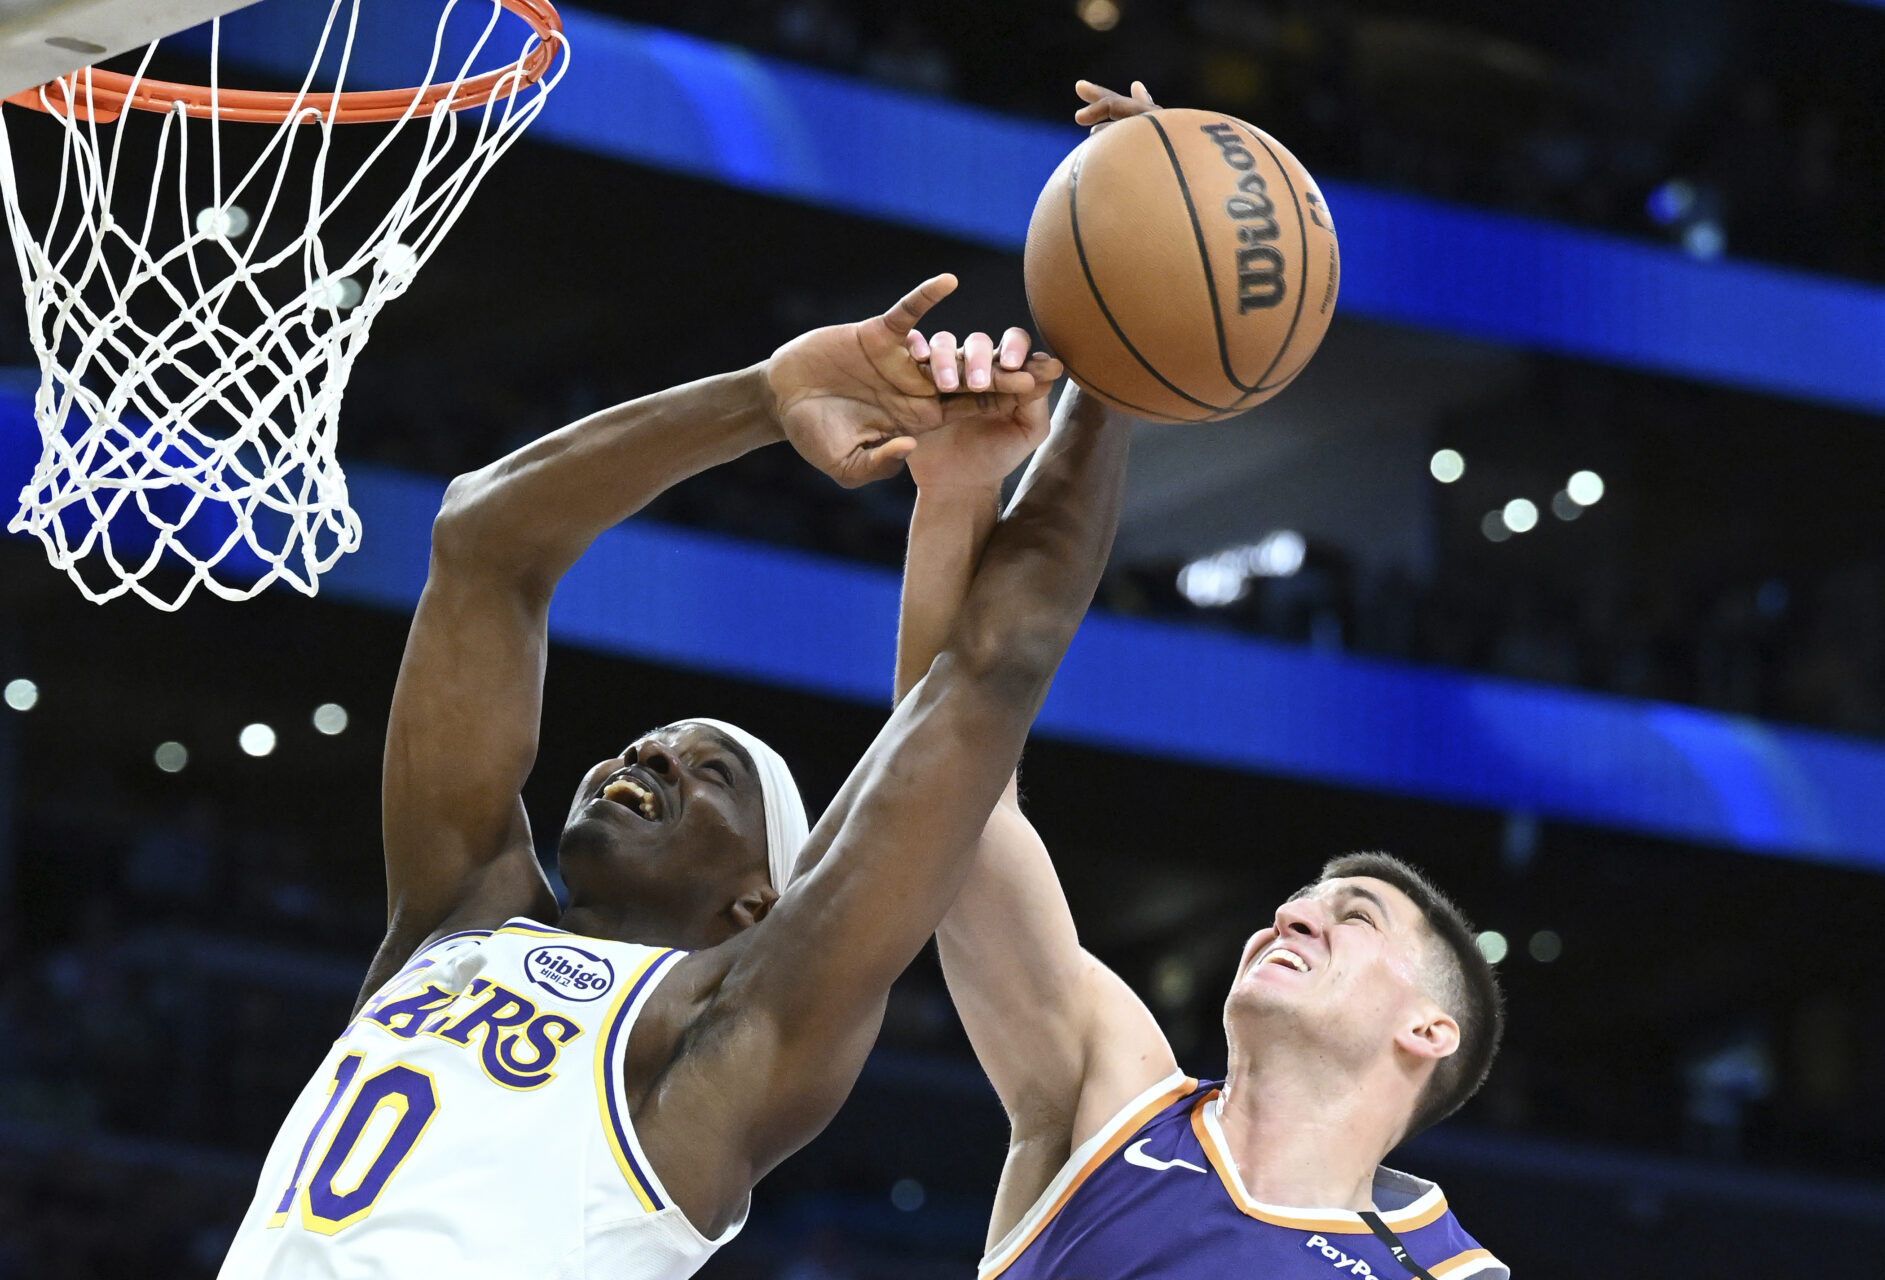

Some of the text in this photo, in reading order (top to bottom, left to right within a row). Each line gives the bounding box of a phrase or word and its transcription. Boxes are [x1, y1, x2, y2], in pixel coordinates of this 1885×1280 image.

[1200, 123, 1287, 315] Wilson
[535, 951, 607, 990] bibigo
[540, 968, 571, 987] 비비고
[267, 1051, 441, 1236] 10
[1390, 1246, 1407, 1262] AL
